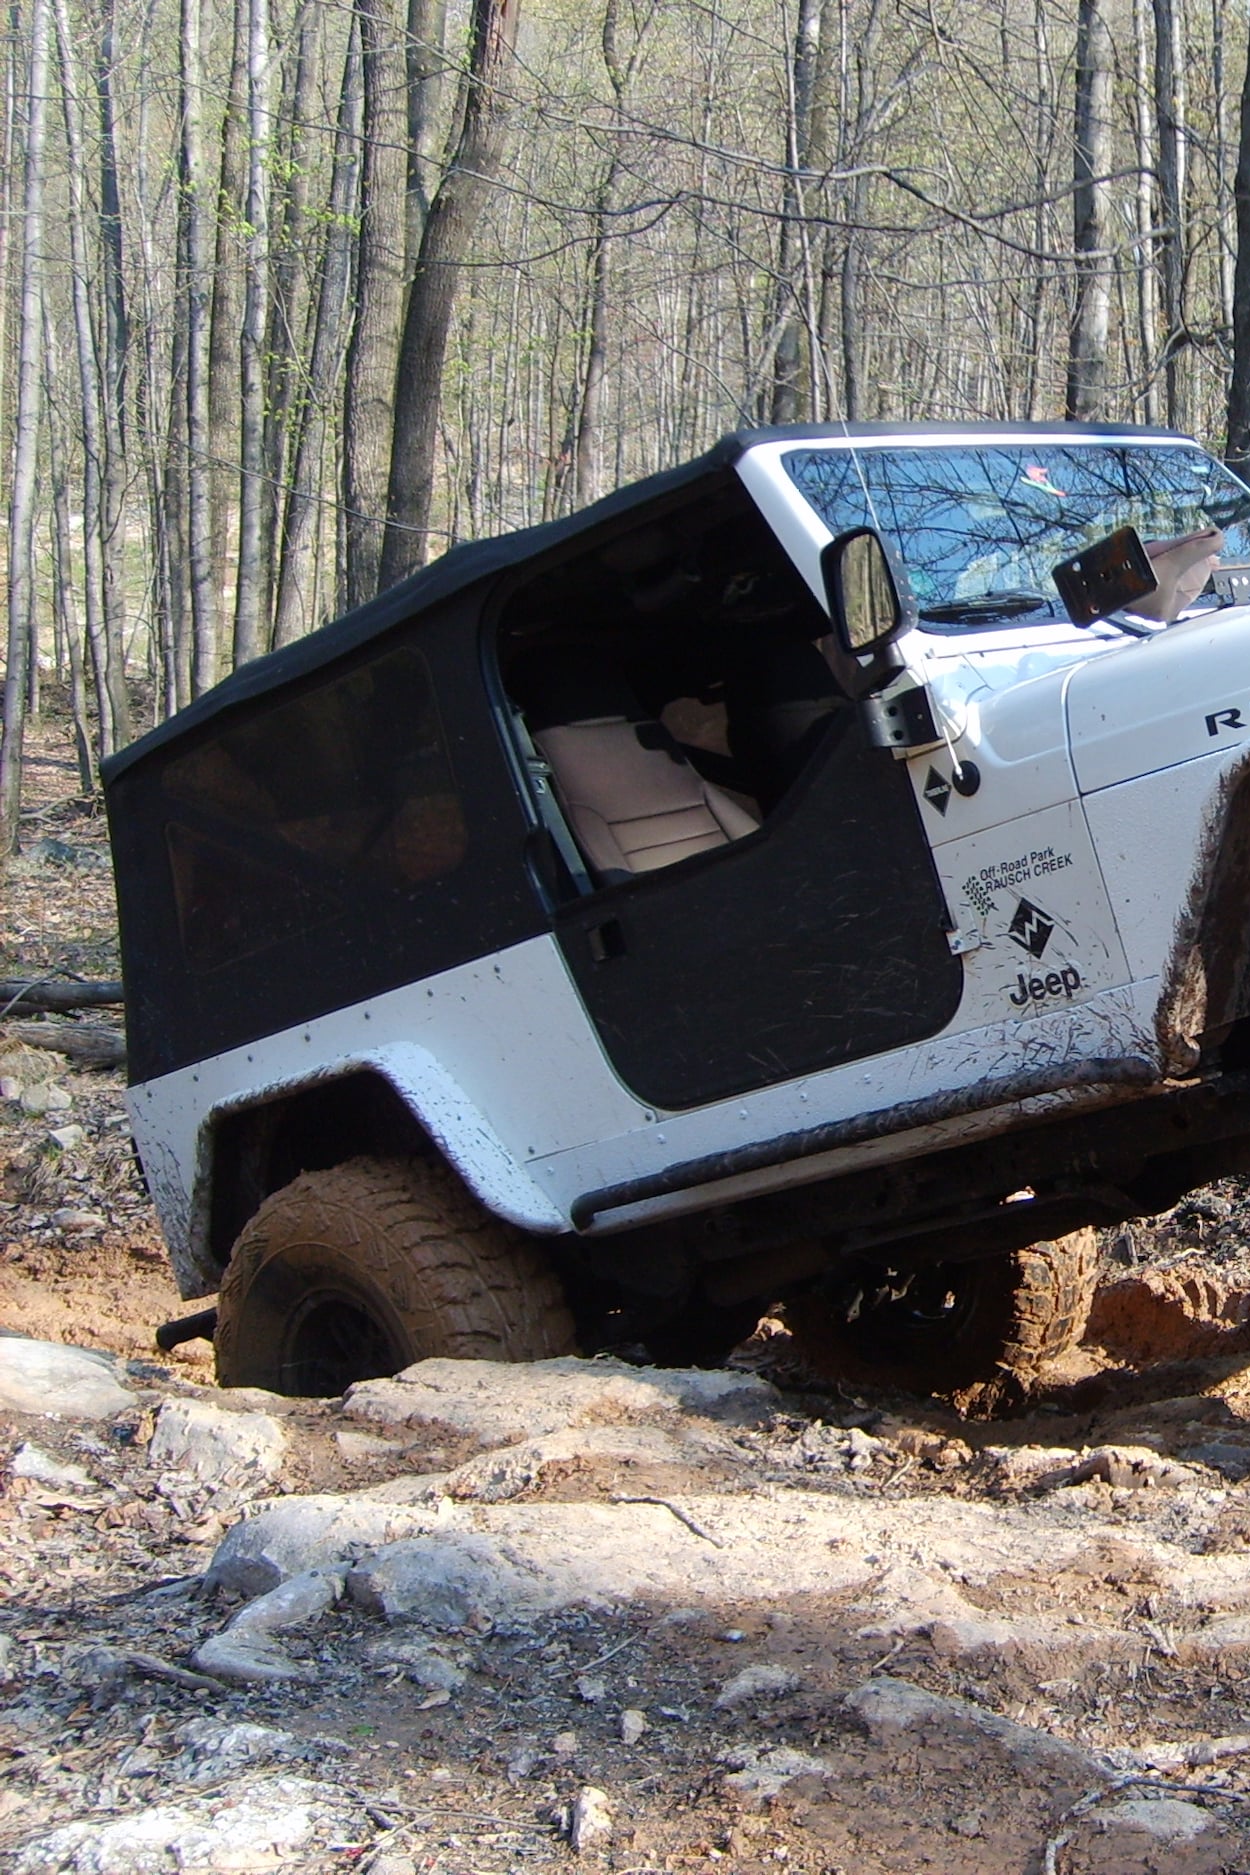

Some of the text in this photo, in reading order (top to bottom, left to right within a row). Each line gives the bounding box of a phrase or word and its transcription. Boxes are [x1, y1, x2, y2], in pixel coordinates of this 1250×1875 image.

[980, 846, 1055, 881] Off-Road Park
[985, 853, 1073, 893] RAUSCH CREEK
[1010, 966, 1081, 1006] Jeep
